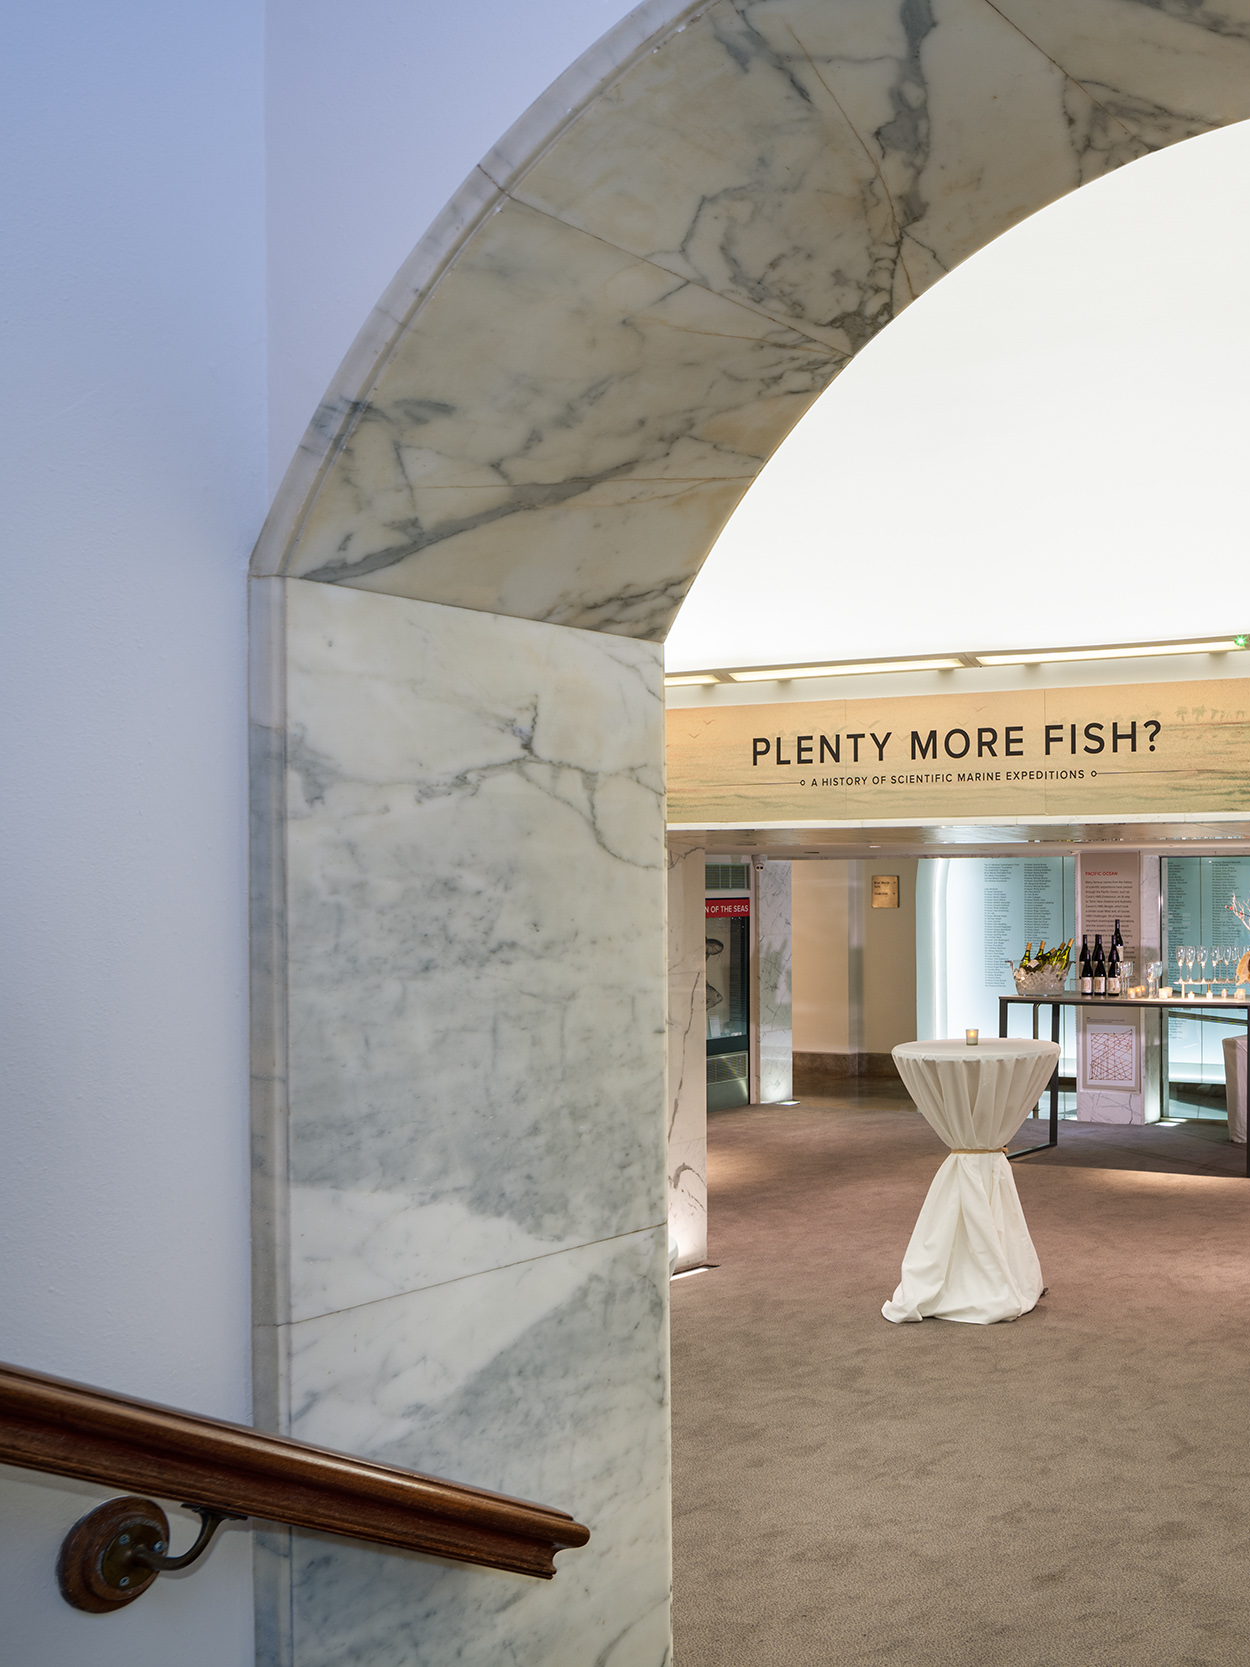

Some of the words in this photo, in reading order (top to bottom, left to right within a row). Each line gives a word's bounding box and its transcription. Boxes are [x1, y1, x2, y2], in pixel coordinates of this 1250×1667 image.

[752, 732, 892, 766] PLENTY
[910, 726, 1024, 760] MORE
[1045, 720, 1162, 756] FISH?
[811, 778, 818, 787] A
[822, 776, 868, 786] HISTORY
[872, 776, 886, 785] OF
[891, 774, 953, 784] SCIENTIFIC
[957, 772, 1001, 782] MARINE
[1006, 770, 1085, 780] EXPEDITIONS
